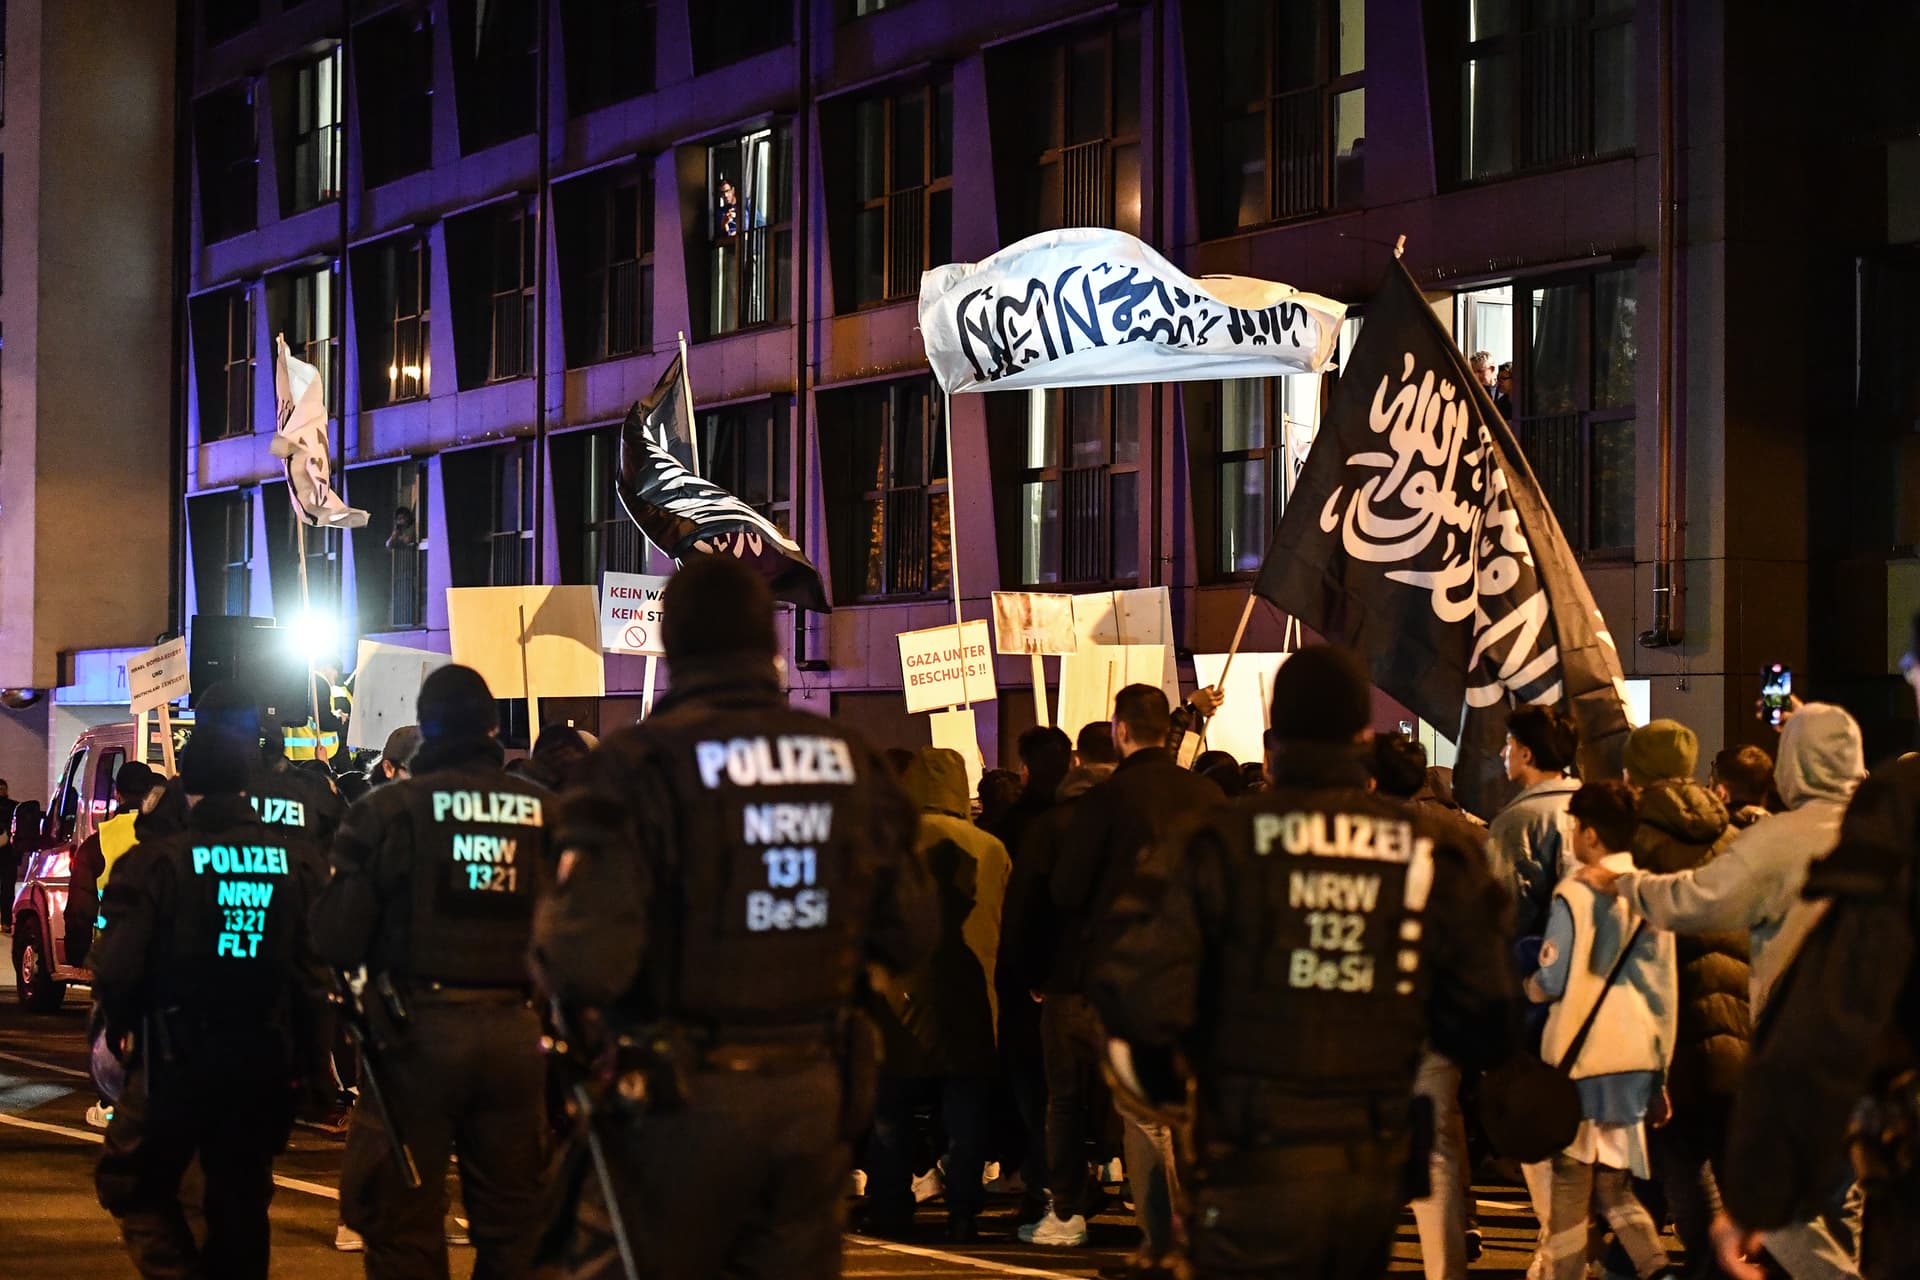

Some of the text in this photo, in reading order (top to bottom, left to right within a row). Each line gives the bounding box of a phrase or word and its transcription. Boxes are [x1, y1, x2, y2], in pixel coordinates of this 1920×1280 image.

[610, 586, 642, 600] KEIN
[611, 607, 643, 620] KEIN
[906, 644, 986, 668] GAZA UNTER
[151, 670, 163, 678] UND
[910, 664, 976, 687] BESCHUSS
[696, 734, 856, 789] POLIZEI
[432, 790, 543, 827] POLIZEI
[744, 803, 833, 845] NRW
[1254, 811, 1411, 864] POLIZEI
[192, 845, 289, 875] POLIZEI
[453, 833, 517, 864] NRW
[466, 863, 516, 892] 1321
[763, 847, 816, 888] 131
[218, 879, 274, 908] NRW
[1289, 870, 1381, 913] NRW
[223, 908, 266, 932] 1321
[746, 889, 829, 931] BeSi
[217, 933, 263, 958] FLT
[1305, 911, 1365, 950] 132
[1288, 949, 1375, 993] BeSi
